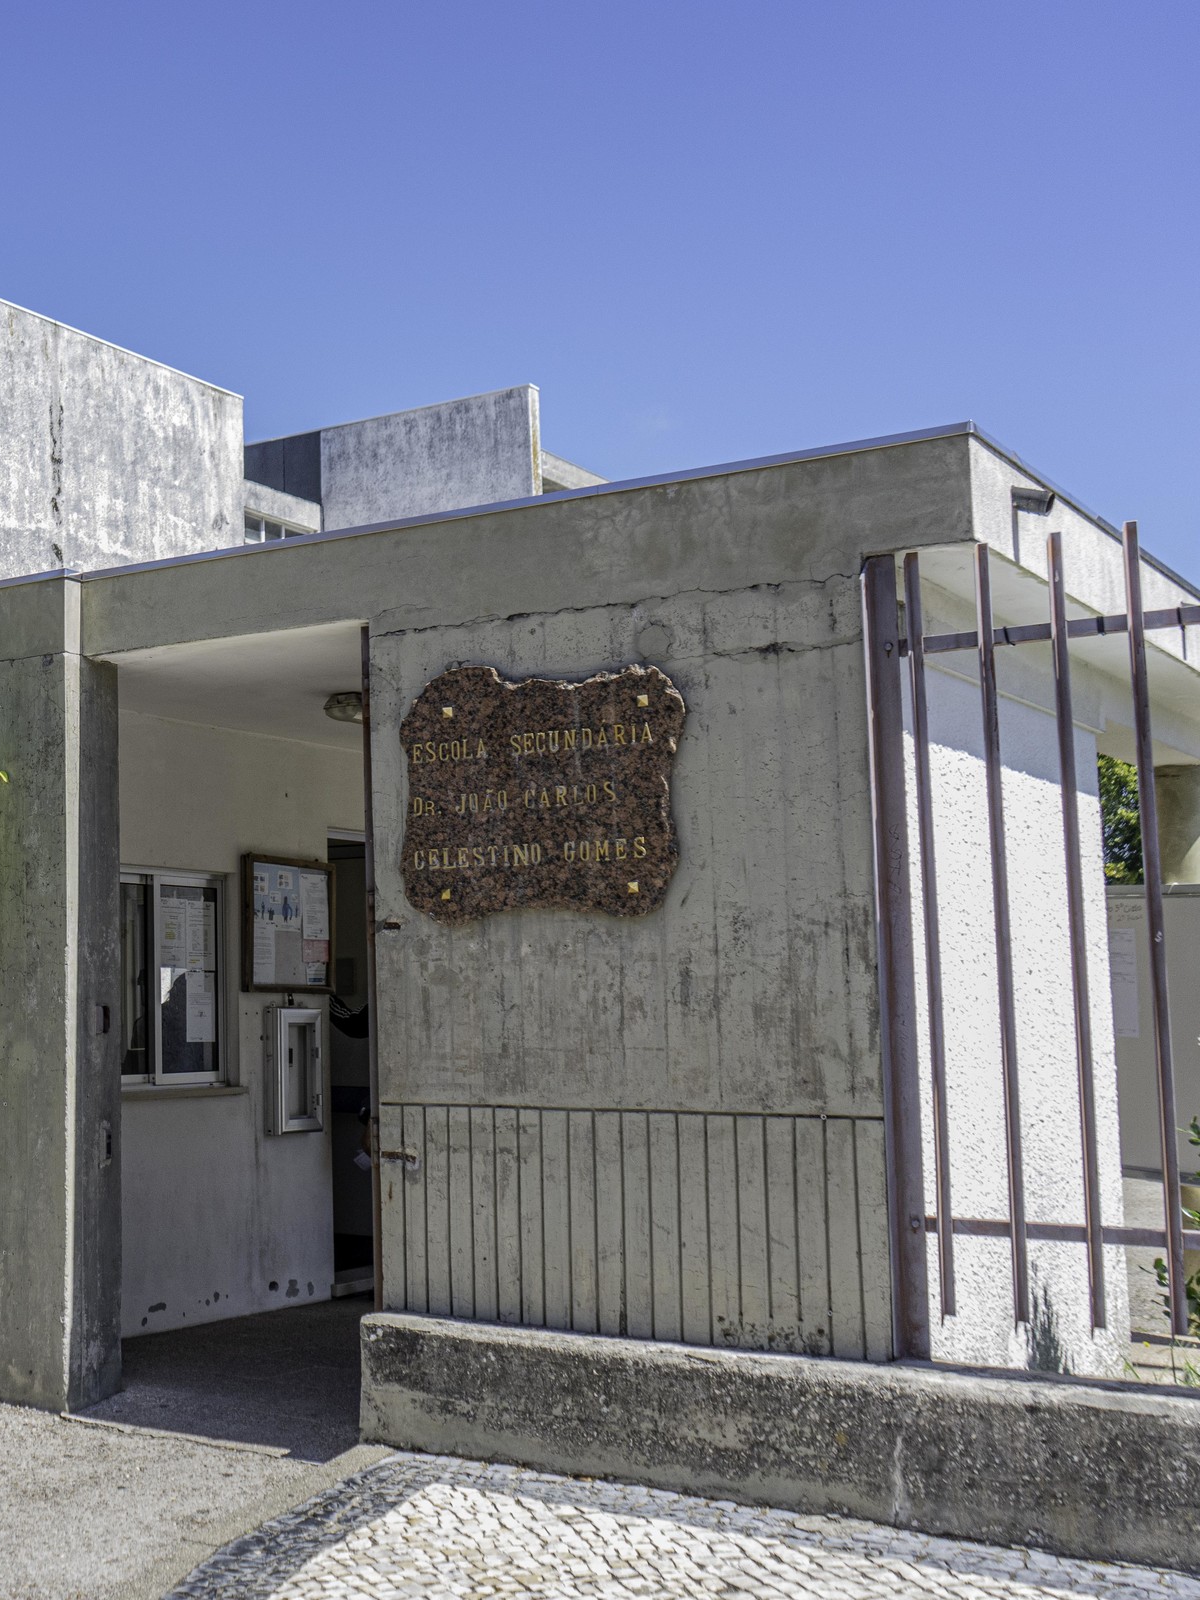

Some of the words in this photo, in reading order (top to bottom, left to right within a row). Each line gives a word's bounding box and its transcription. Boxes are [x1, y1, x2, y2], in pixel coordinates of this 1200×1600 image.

[413, 738, 488, 764] ESCOLA
[510, 719, 654, 755] SECUNDÁRIA
[413, 796, 443, 816] DR.
[455, 788, 508, 815] JOÃO
[524, 780, 617, 809] CARLOS
[414, 844, 541, 871] CELESTINO
[563, 836, 647, 863] GOMES
